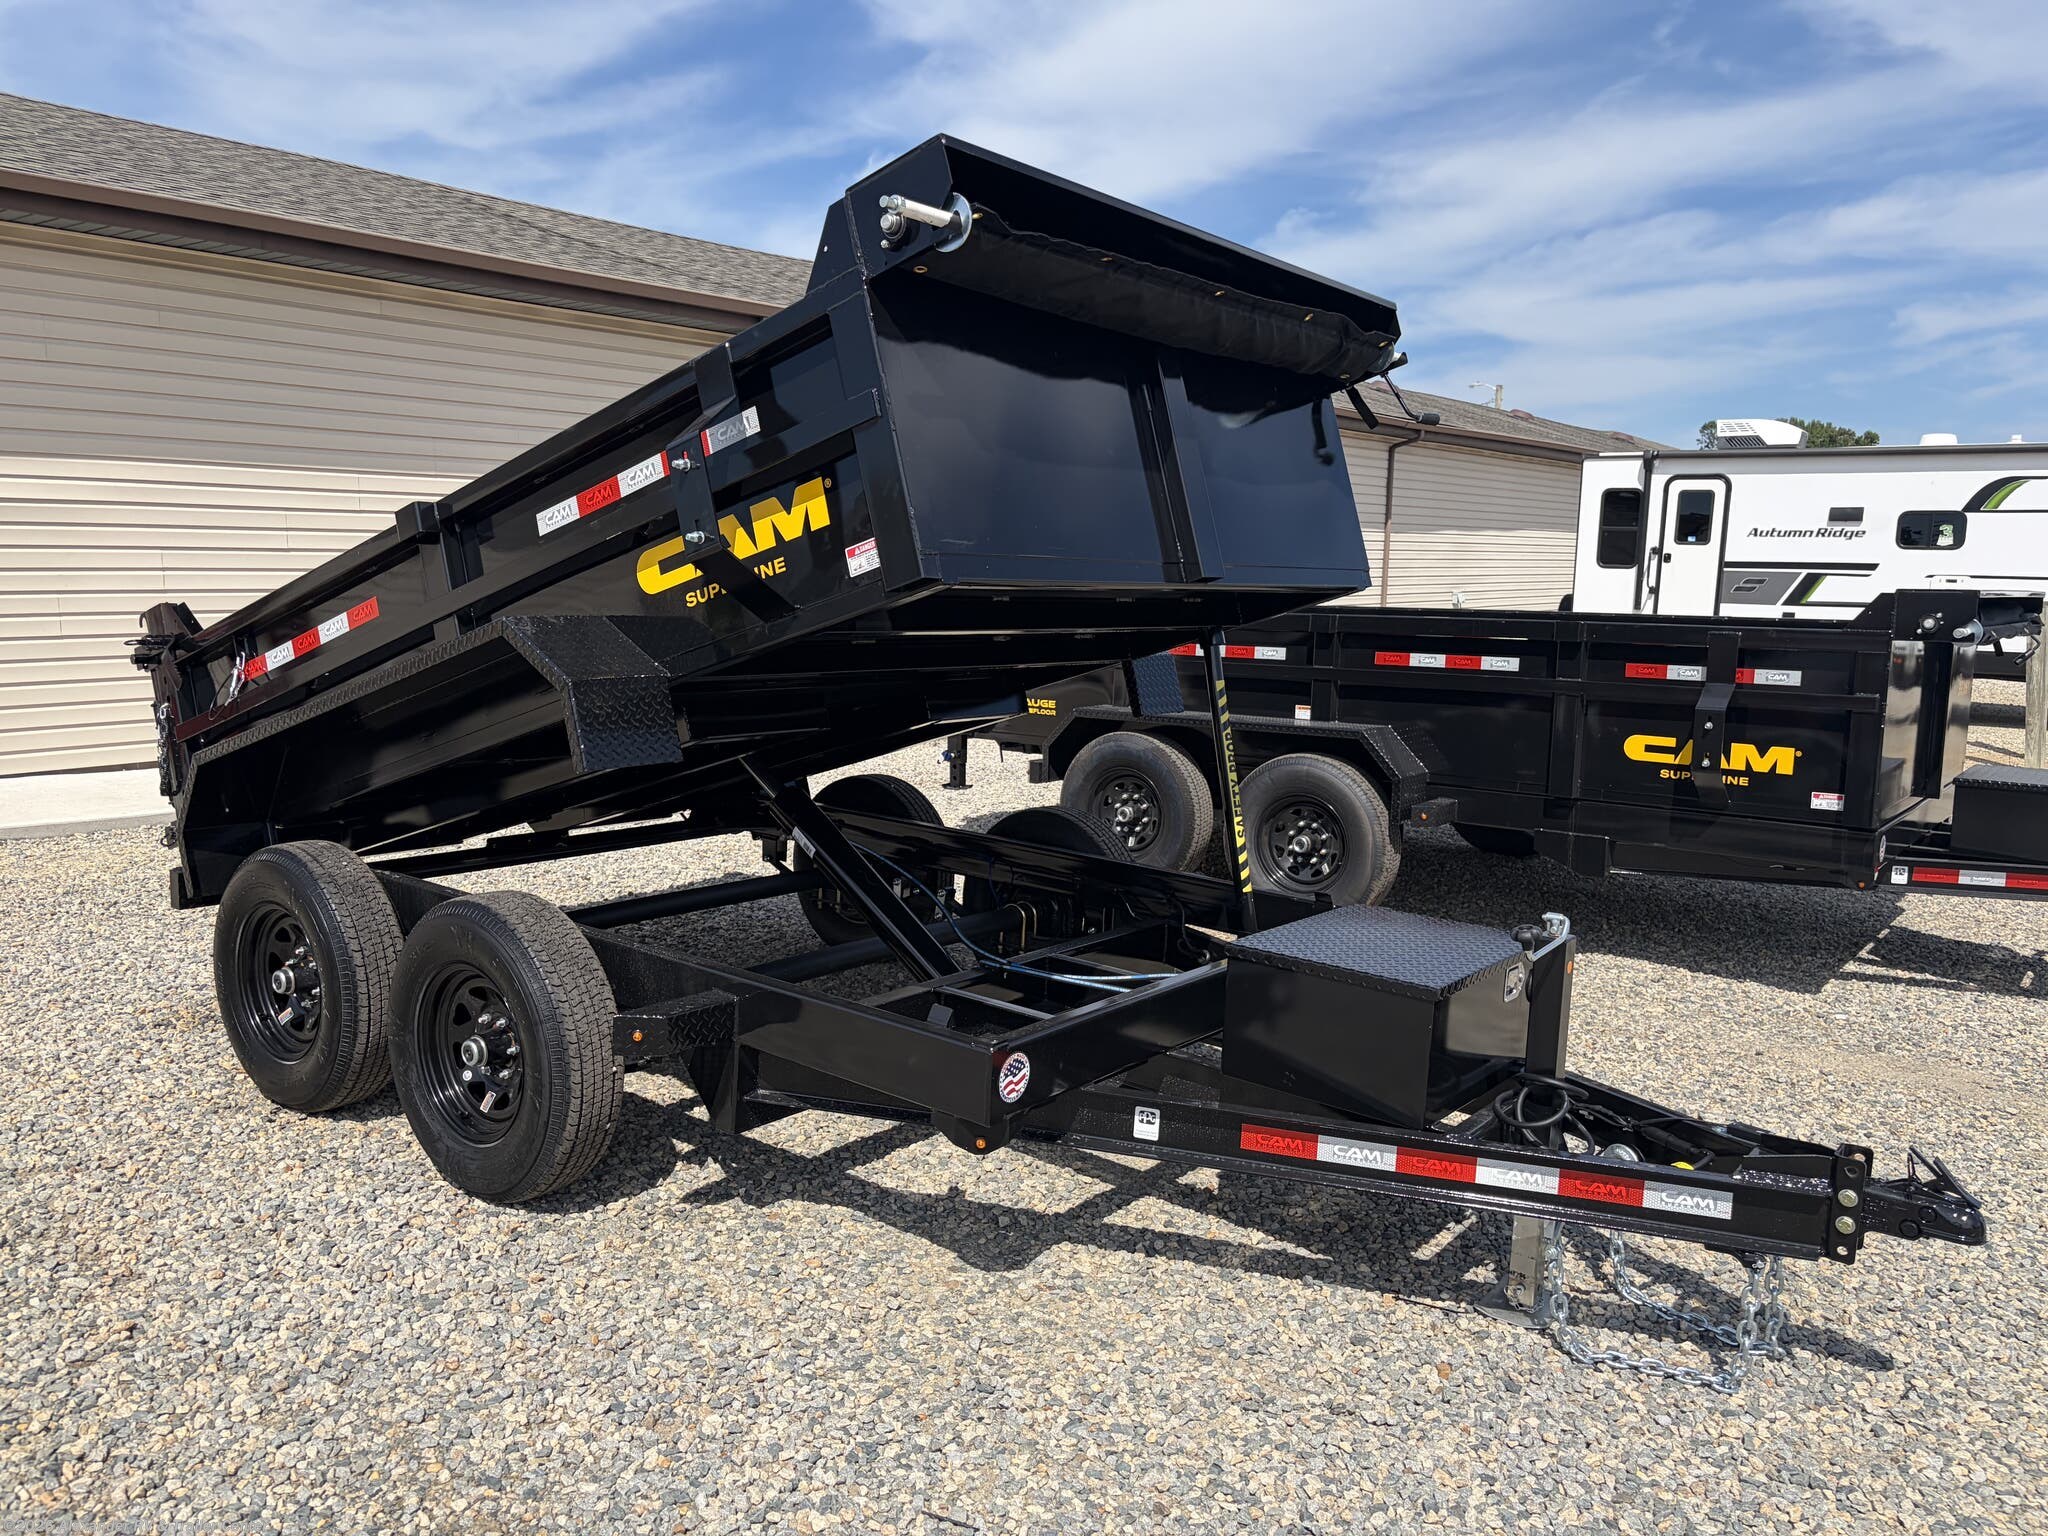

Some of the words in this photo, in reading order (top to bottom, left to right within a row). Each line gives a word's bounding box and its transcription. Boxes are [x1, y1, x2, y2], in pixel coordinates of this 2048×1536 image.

[544, 504, 571, 523] CAM
[586, 483, 612, 507] CAM
[628, 462, 655, 484] CAM
[718, 416, 750, 440] CAM
[1747, 527, 1814, 538] Autumn
[1815, 527, 1866, 541] Ridge
[271, 646, 289, 663] CAM
[297, 634, 316, 650] CAM
[325, 619, 344, 636] CAM
[353, 603, 373, 621] CAM
[1256, 1134, 1303, 1151] CAM
[1333, 1144, 1381, 1163] CAM
[1412, 1156, 1462, 1175] CAM
[1492, 1167, 1543, 1187] CAM
[1575, 1179, 1626, 1197] CAM
[1661, 1191, 1714, 1212] CAM
